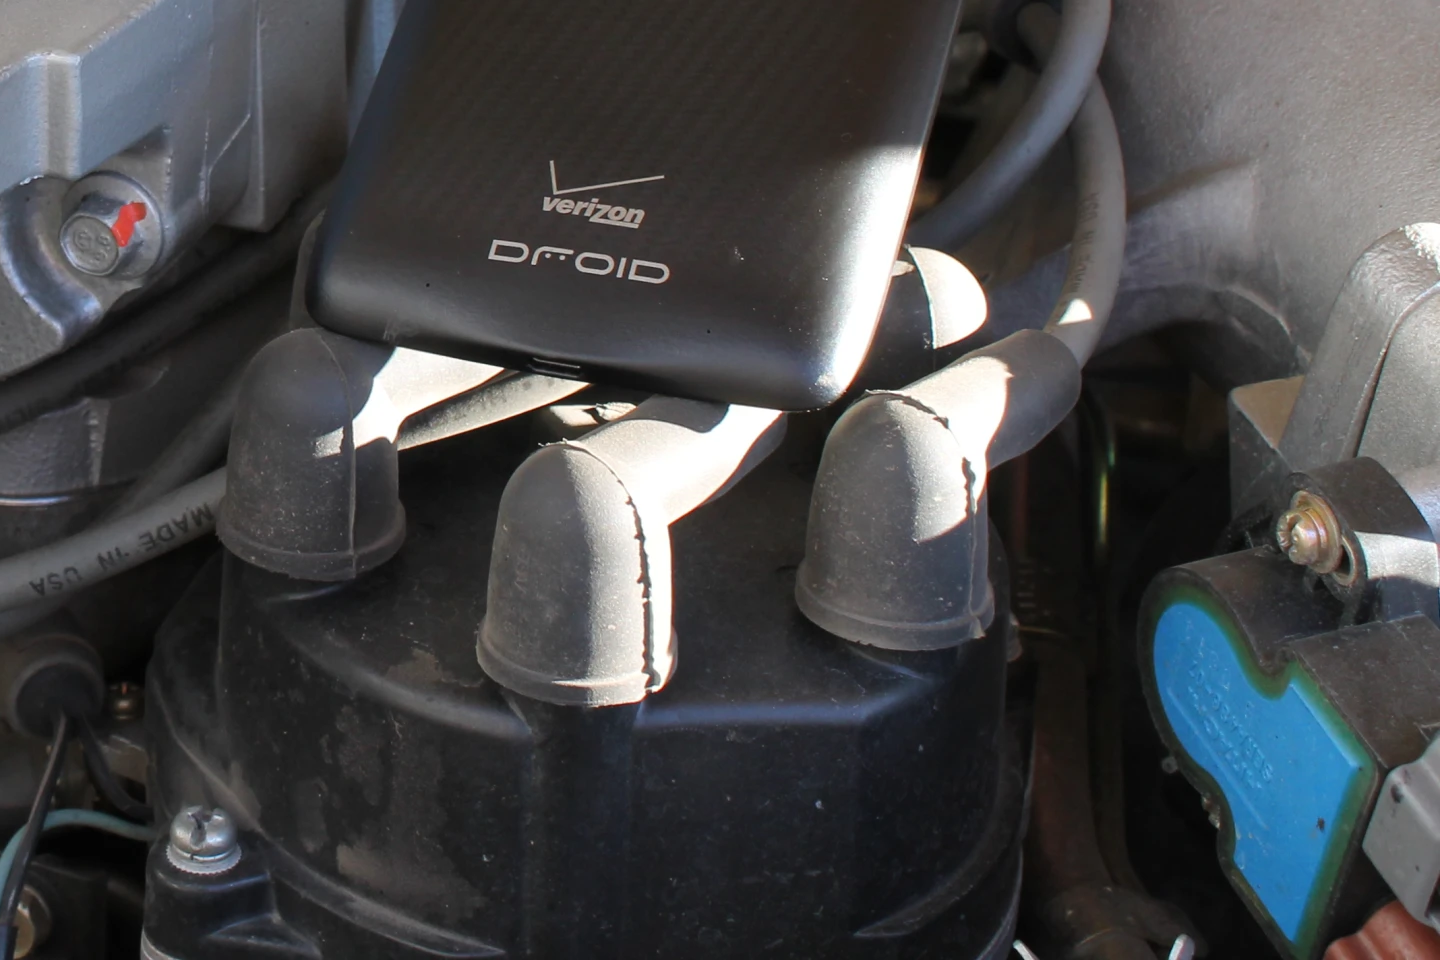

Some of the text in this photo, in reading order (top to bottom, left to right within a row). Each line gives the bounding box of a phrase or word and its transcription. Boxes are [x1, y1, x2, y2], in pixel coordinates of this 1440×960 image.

[542, 196, 646, 229] verizon
[487, 239, 671, 284] DROID
[28, 502, 215, 597] MADE IN USA
